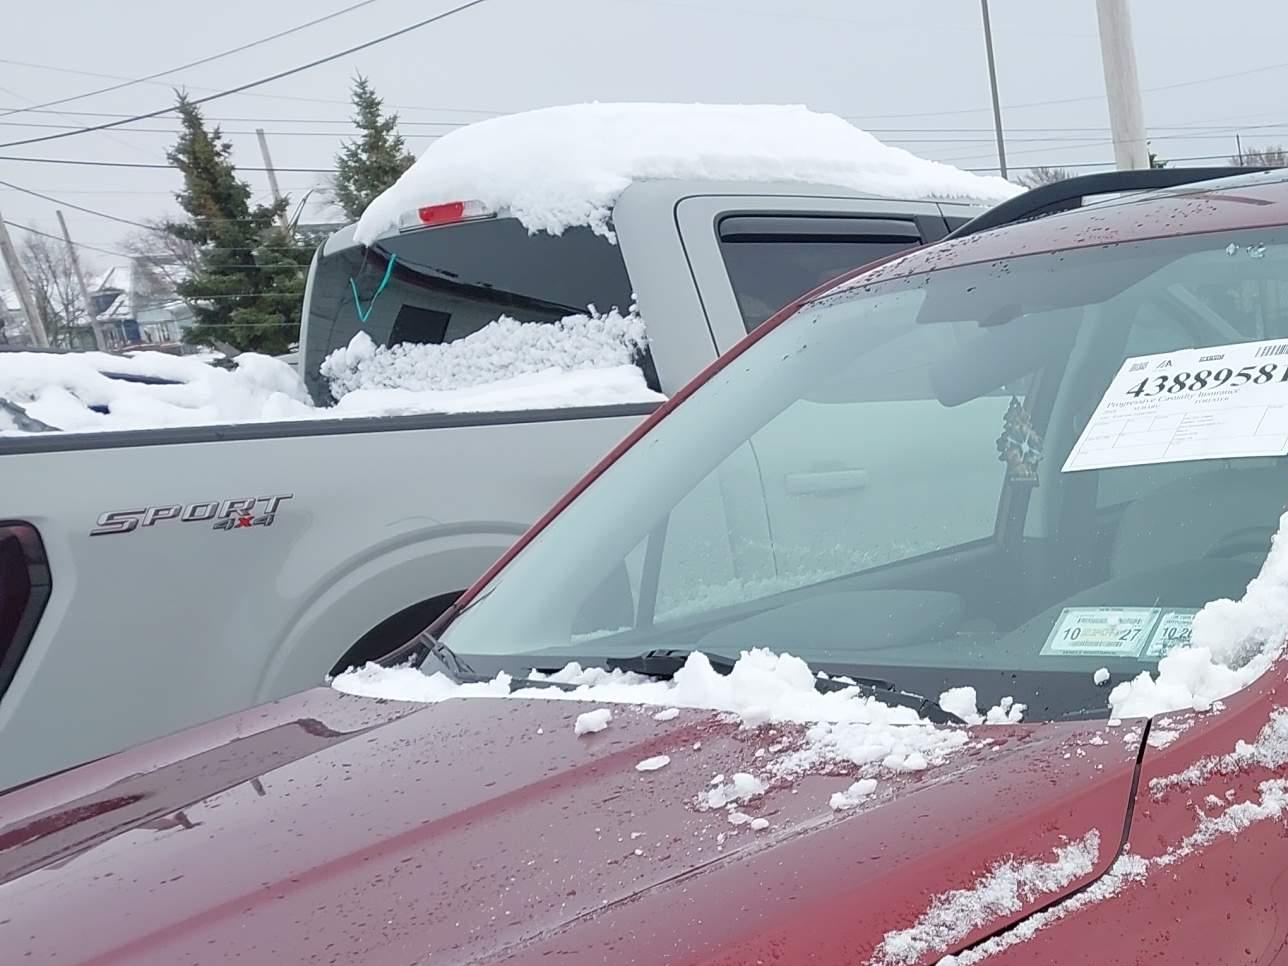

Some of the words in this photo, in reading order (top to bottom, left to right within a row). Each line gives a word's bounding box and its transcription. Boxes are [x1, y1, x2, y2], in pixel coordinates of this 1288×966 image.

[89, 492, 295, 537] SPORT
[1063, 627, 1082, 641] 10
[1118, 628, 1142, 642] 27
